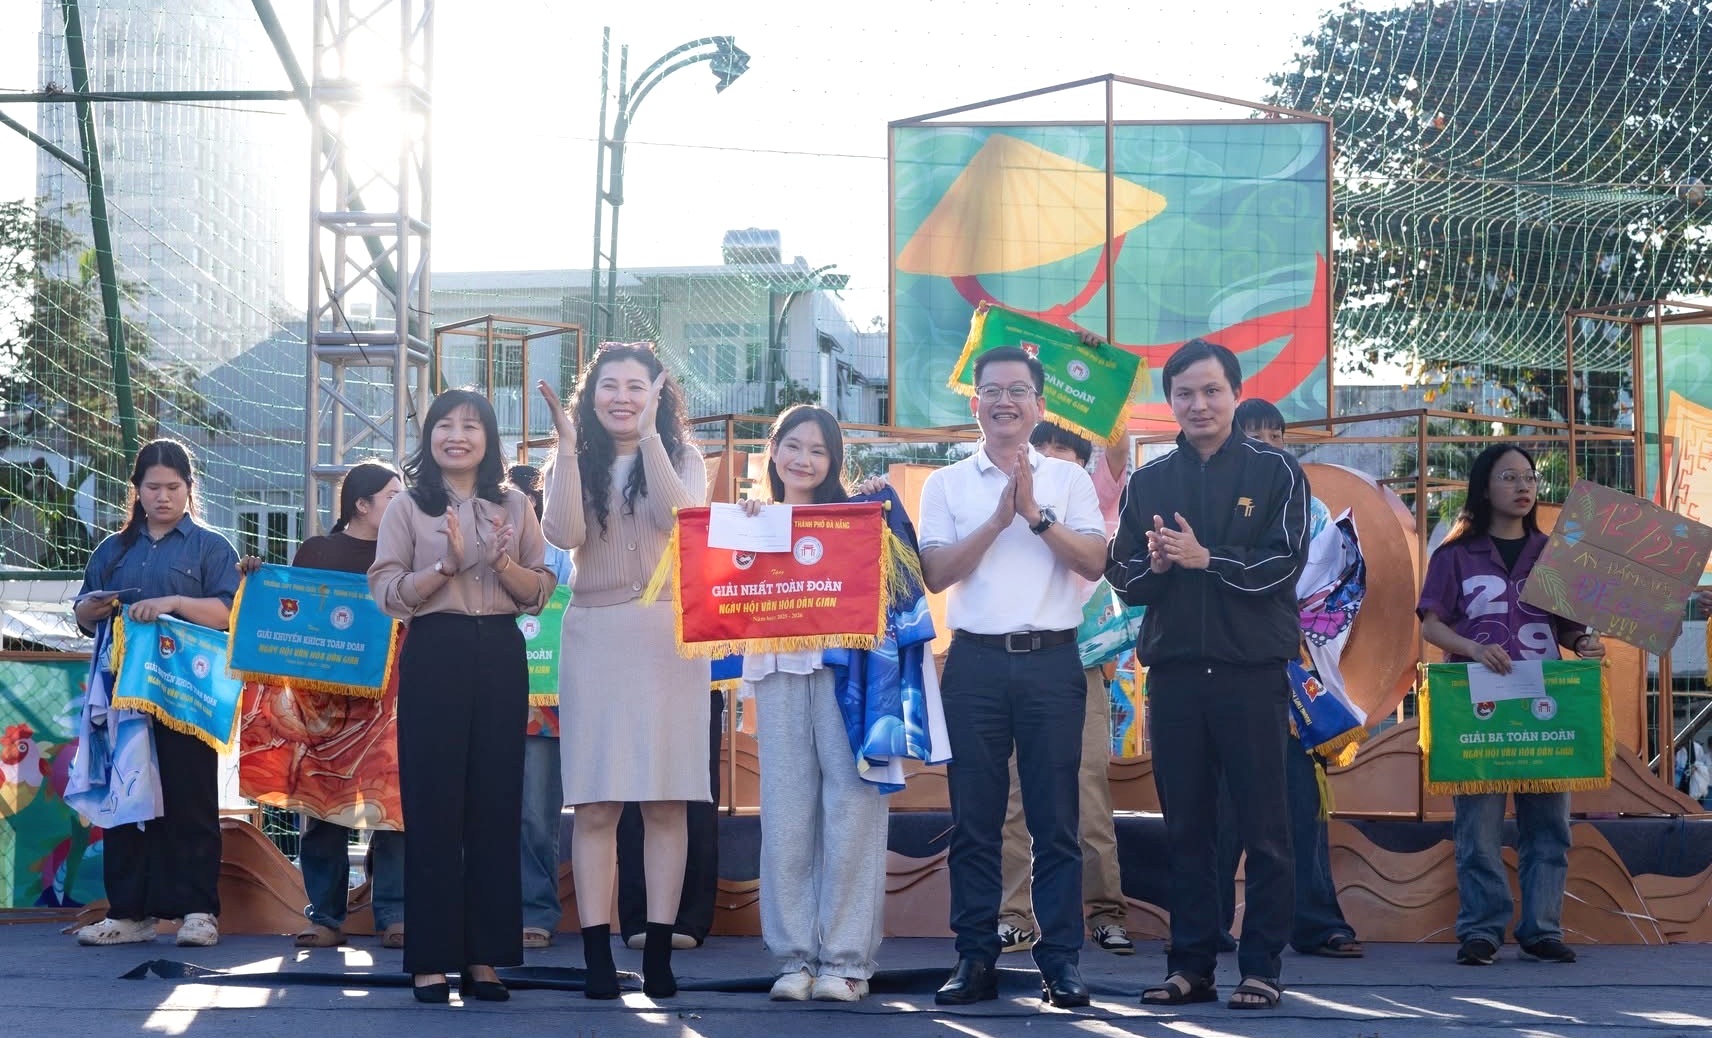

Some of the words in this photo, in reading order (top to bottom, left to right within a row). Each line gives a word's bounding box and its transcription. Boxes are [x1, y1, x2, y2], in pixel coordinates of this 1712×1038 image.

[711, 581, 738, 597] GIẢI
[740, 579, 774, 596] NHẤT
[775, 578, 804, 594] TOÀN
[806, 578, 842, 592] ĐOÀN
[719, 600, 741, 615] NGÀY
[743, 599, 759, 614] HỘI
[815, 597, 837, 608] GIAN
[1459, 730, 1486, 744] GIẢI
[1488, 732, 1504, 743] BA
[1506, 729, 1539, 742] TOÀN
[1541, 728, 1576, 741] ĐOÀN
